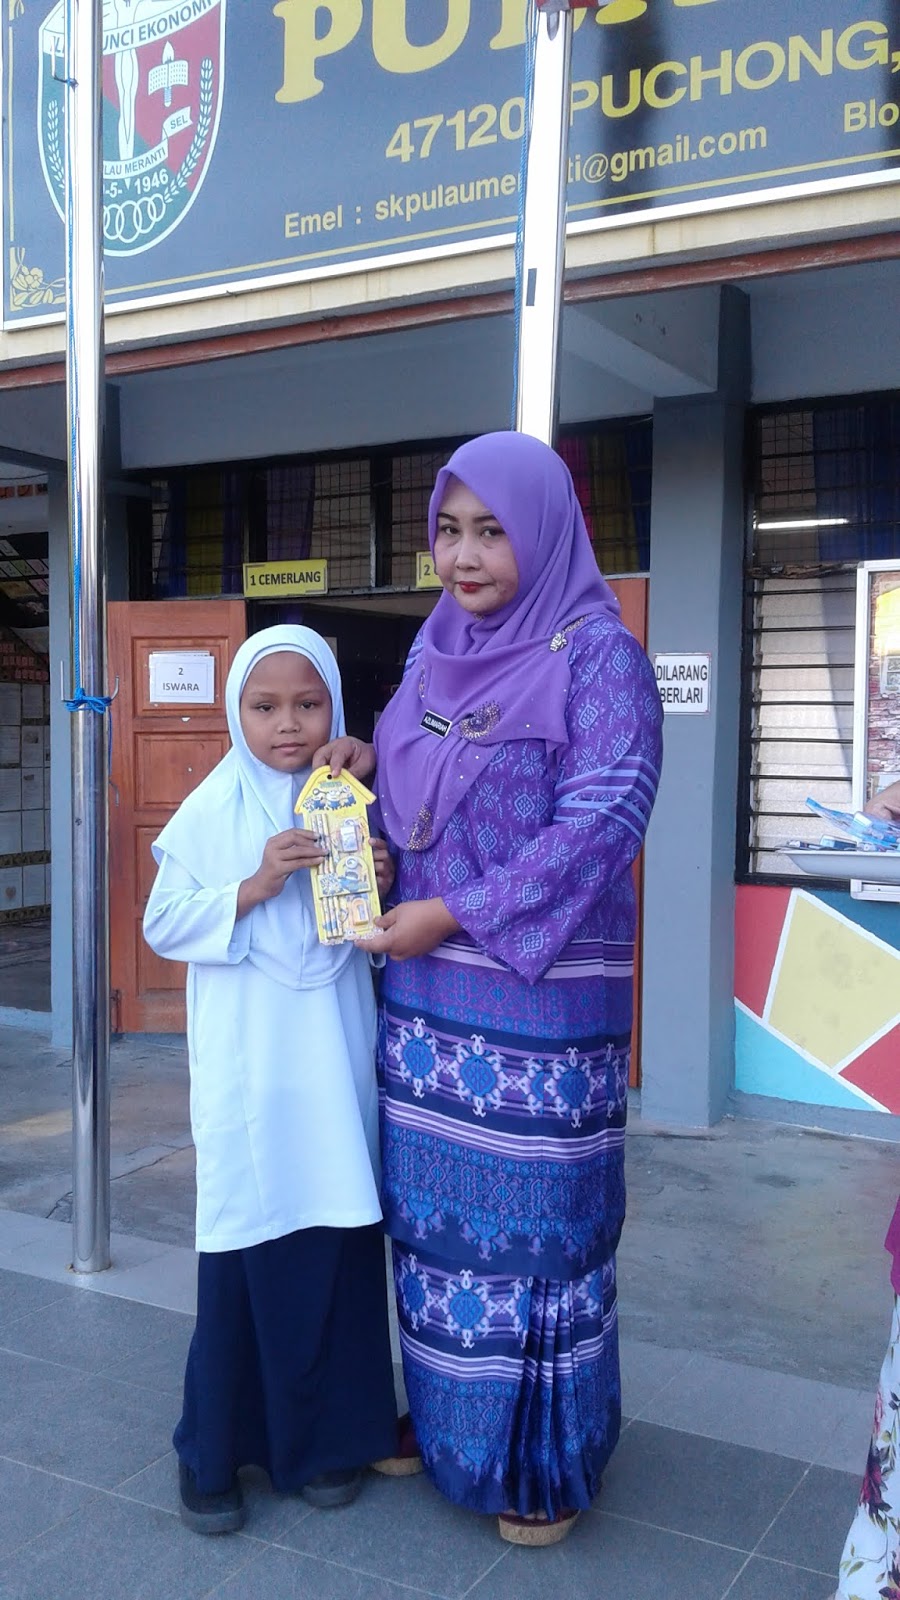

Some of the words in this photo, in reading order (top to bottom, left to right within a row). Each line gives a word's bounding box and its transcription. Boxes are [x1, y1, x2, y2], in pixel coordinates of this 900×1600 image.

[103, 29, 134, 51] UNCI
[170, 114, 188, 130] SEL
[844, 98, 900, 133] Blo
[385, 96, 527, 162] 47120
[125, 147, 167, 174] MERANTI
[134, 169, 169, 194] 1946
[285, 205, 343, 238] Emel
[423, 564, 430, 576] 2
[250, 575, 256, 586] 1
[259, 571, 321, 585] CEMERLANG
[178, 667, 184, 676] 2
[656, 665, 707, 681] DILARANG
[162, 682, 200, 692] ISWARA
[659, 687, 703, 703] BERLARI
